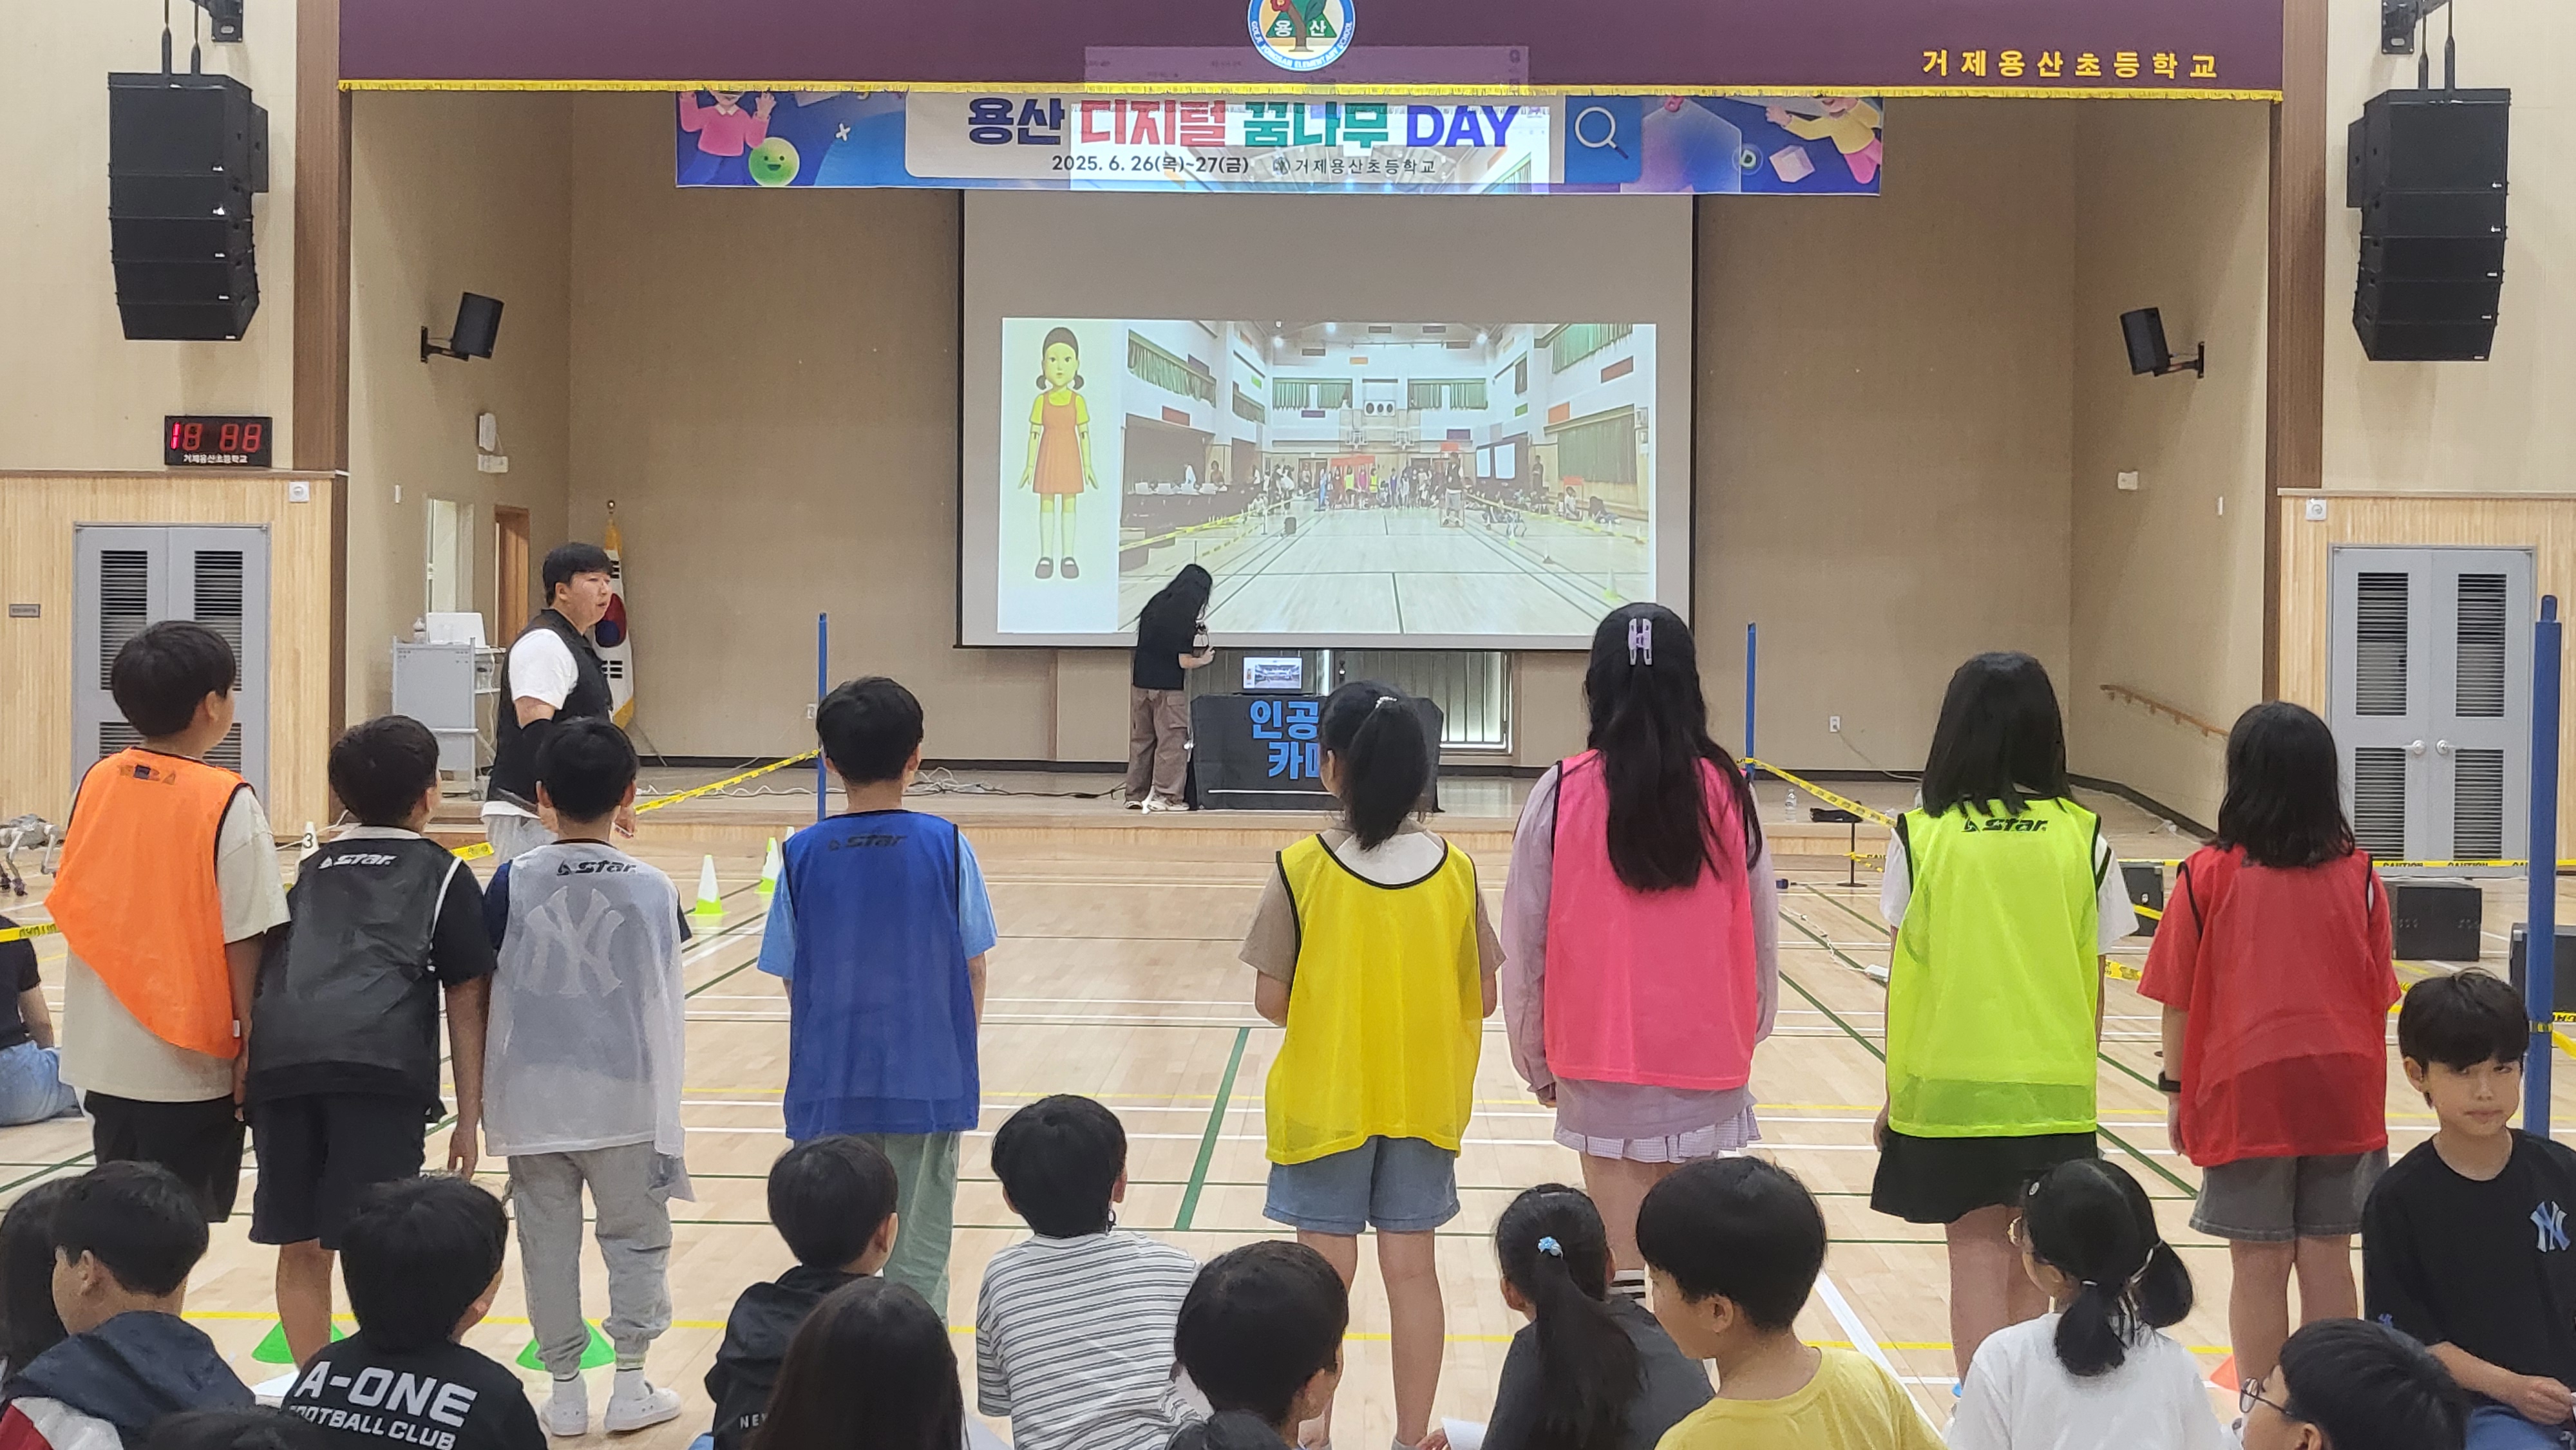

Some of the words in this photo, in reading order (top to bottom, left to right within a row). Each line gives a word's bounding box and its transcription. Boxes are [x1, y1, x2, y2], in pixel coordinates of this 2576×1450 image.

[967, 97, 1065, 146] 용산
[1081, 99, 1226, 147] 디지털
[1243, 101, 1389, 149] 꿈나무
[1406, 104, 1521, 147] DAY
[1052, 155, 1103, 171] 2025.
[1108, 155, 1125, 171] 6.
[1295, 158, 1436, 175] 거제용산초등학교
[1250, 701, 1319, 739] 인공
[303, 833, 313, 849] 3
[294, 1361, 478, 1427] A-ONE
[387, 1420, 456, 1450] CLUB
